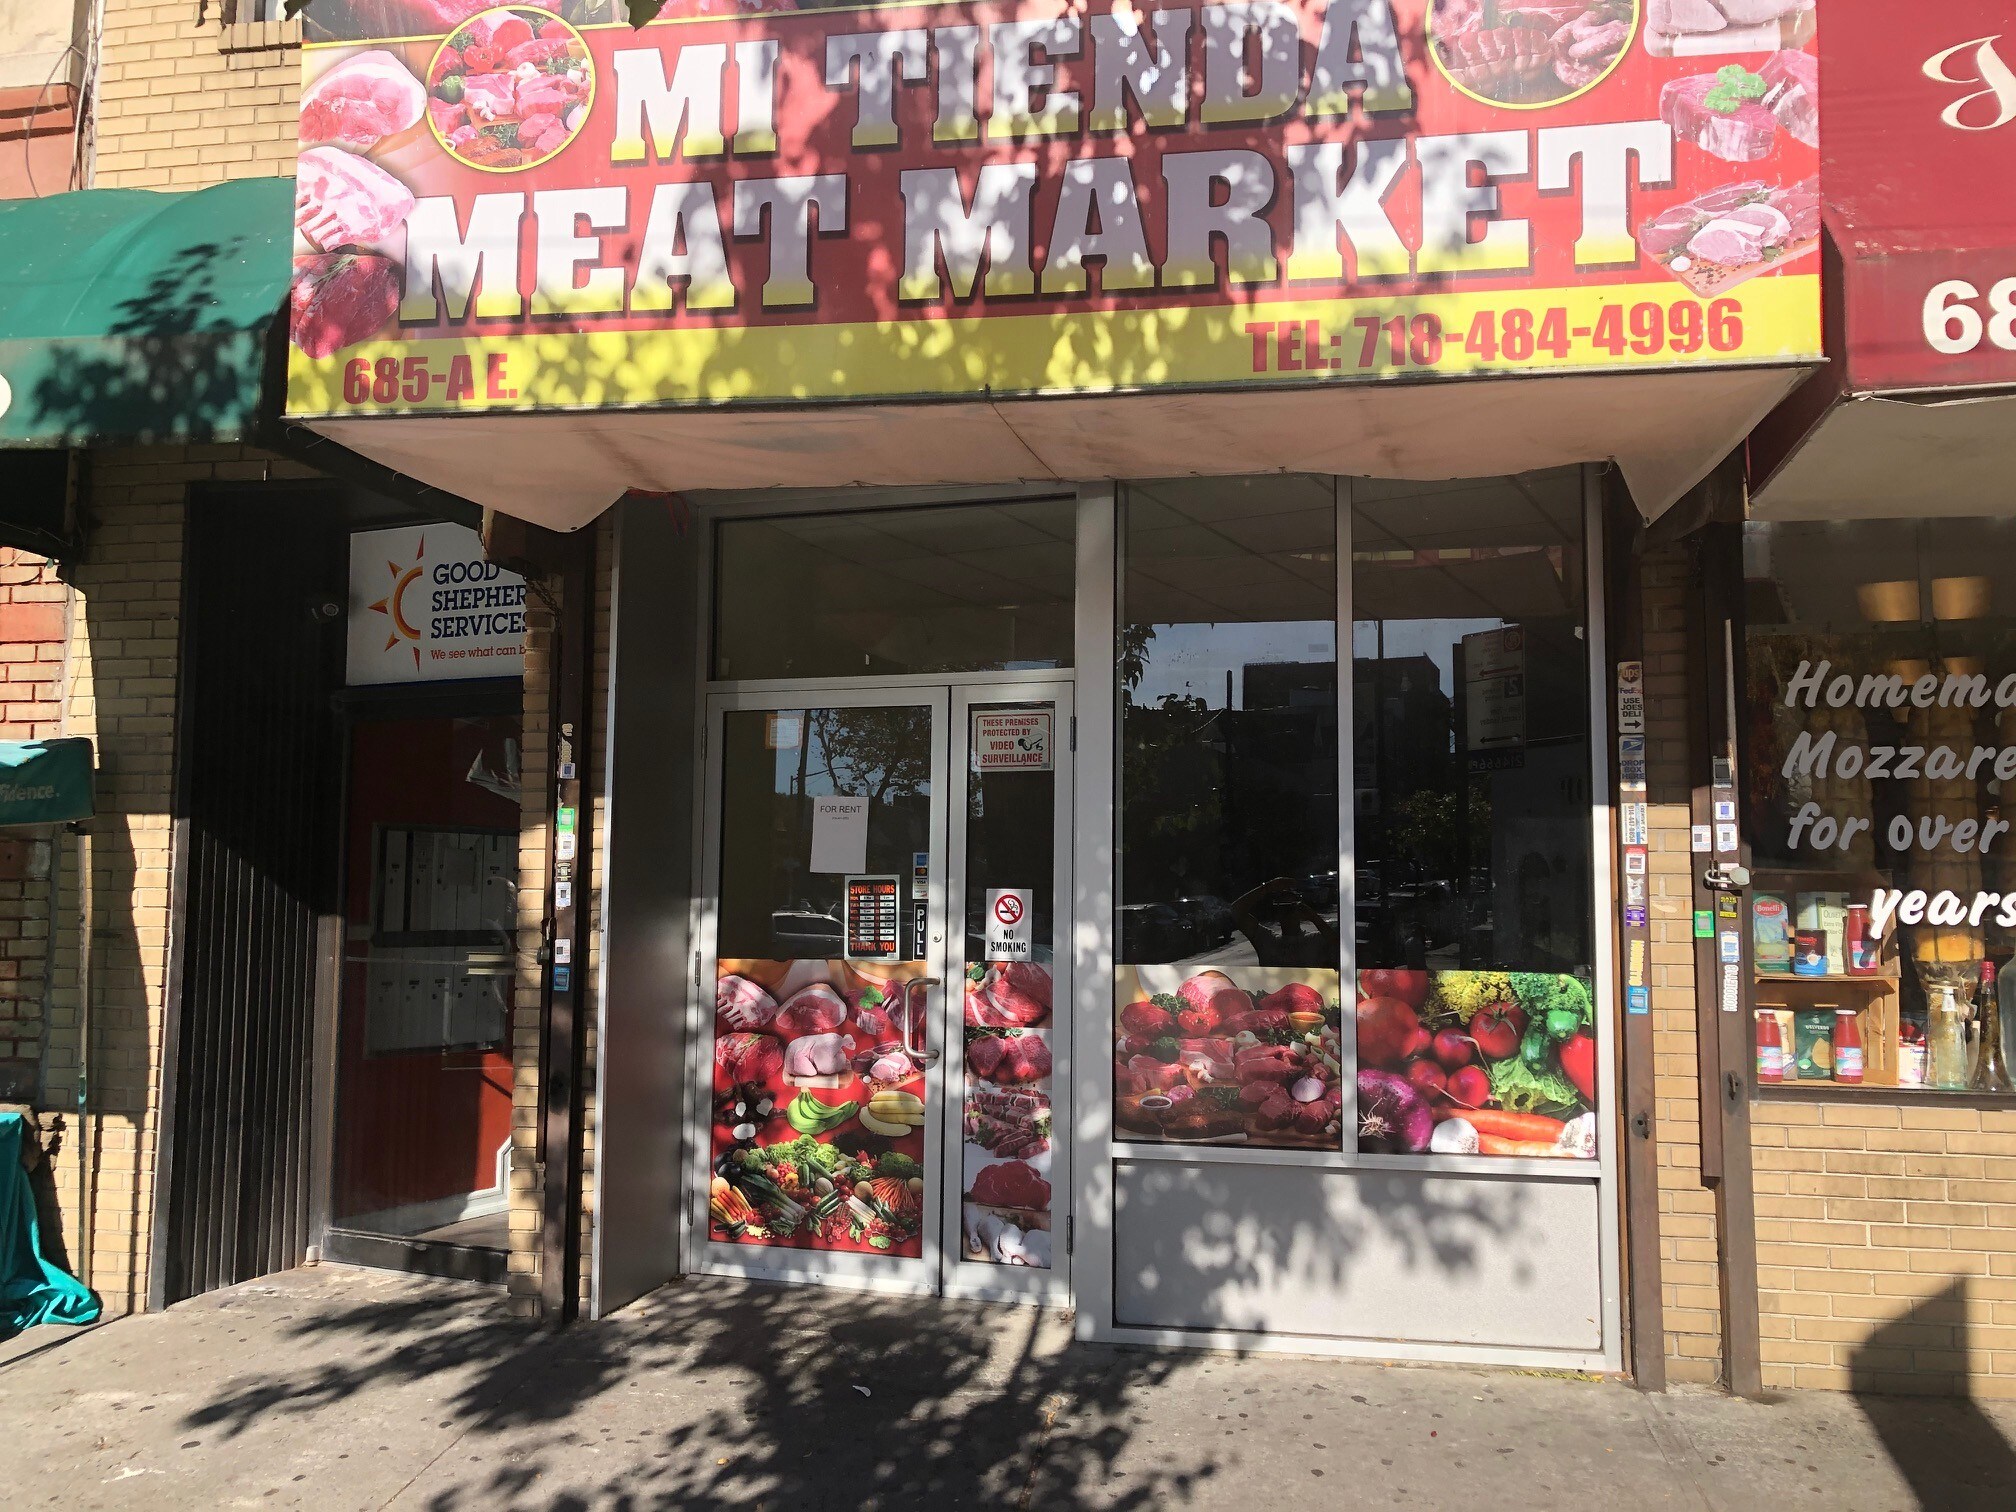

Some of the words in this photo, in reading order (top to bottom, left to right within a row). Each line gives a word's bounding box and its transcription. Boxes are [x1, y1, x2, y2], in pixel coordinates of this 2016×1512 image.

[610, 39, 780, 164] MI
[825, 0, 1413, 150] TIENDA
[400, 174, 847, 324] MEAT
[899, 120, 1674, 303] MARKET
[1245, 319, 1342, 373] TEL:
[1354, 298, 1744, 367] 718-484-4996
[343, 355, 475, 404] 685-A
[487, 353, 518, 399] E.
[433, 561, 500, 585] GOOD
[431, 612, 527, 638] SERVICE
[431, 649, 446, 660] We
[449, 649, 466, 659] see
[468, 646, 494, 658] what
[496, 646, 516, 656] can
[1623, 669, 1639, 681] ups
[982, 719, 1003, 727] THESE
[1005, 717, 1039, 726] PREMISES
[982, 729, 1020, 737] PROTECTED
[990, 740, 1014, 750] VIDEO
[982, 753, 1043, 763] SURVEILLANCE
[1781, 730, 2016, 780] Mozzare
[1621, 772, 1646, 780] HERE
[820, 805, 837, 813] FOR
[839, 805, 862, 813] RENT
[1787, 802, 1869, 850] for
[1888, 815, 2010, 853] over
[850, 885, 871, 894] STORE
[873, 884, 895, 894] HOURS
[1869, 888, 2016, 939] years
[916, 908, 925, 956] PULL
[1003, 929, 1014, 939] NO
[850, 941, 877, 951] THANK
[880, 941, 895, 951] YOU
[990, 942, 1027, 952] SMOKING
